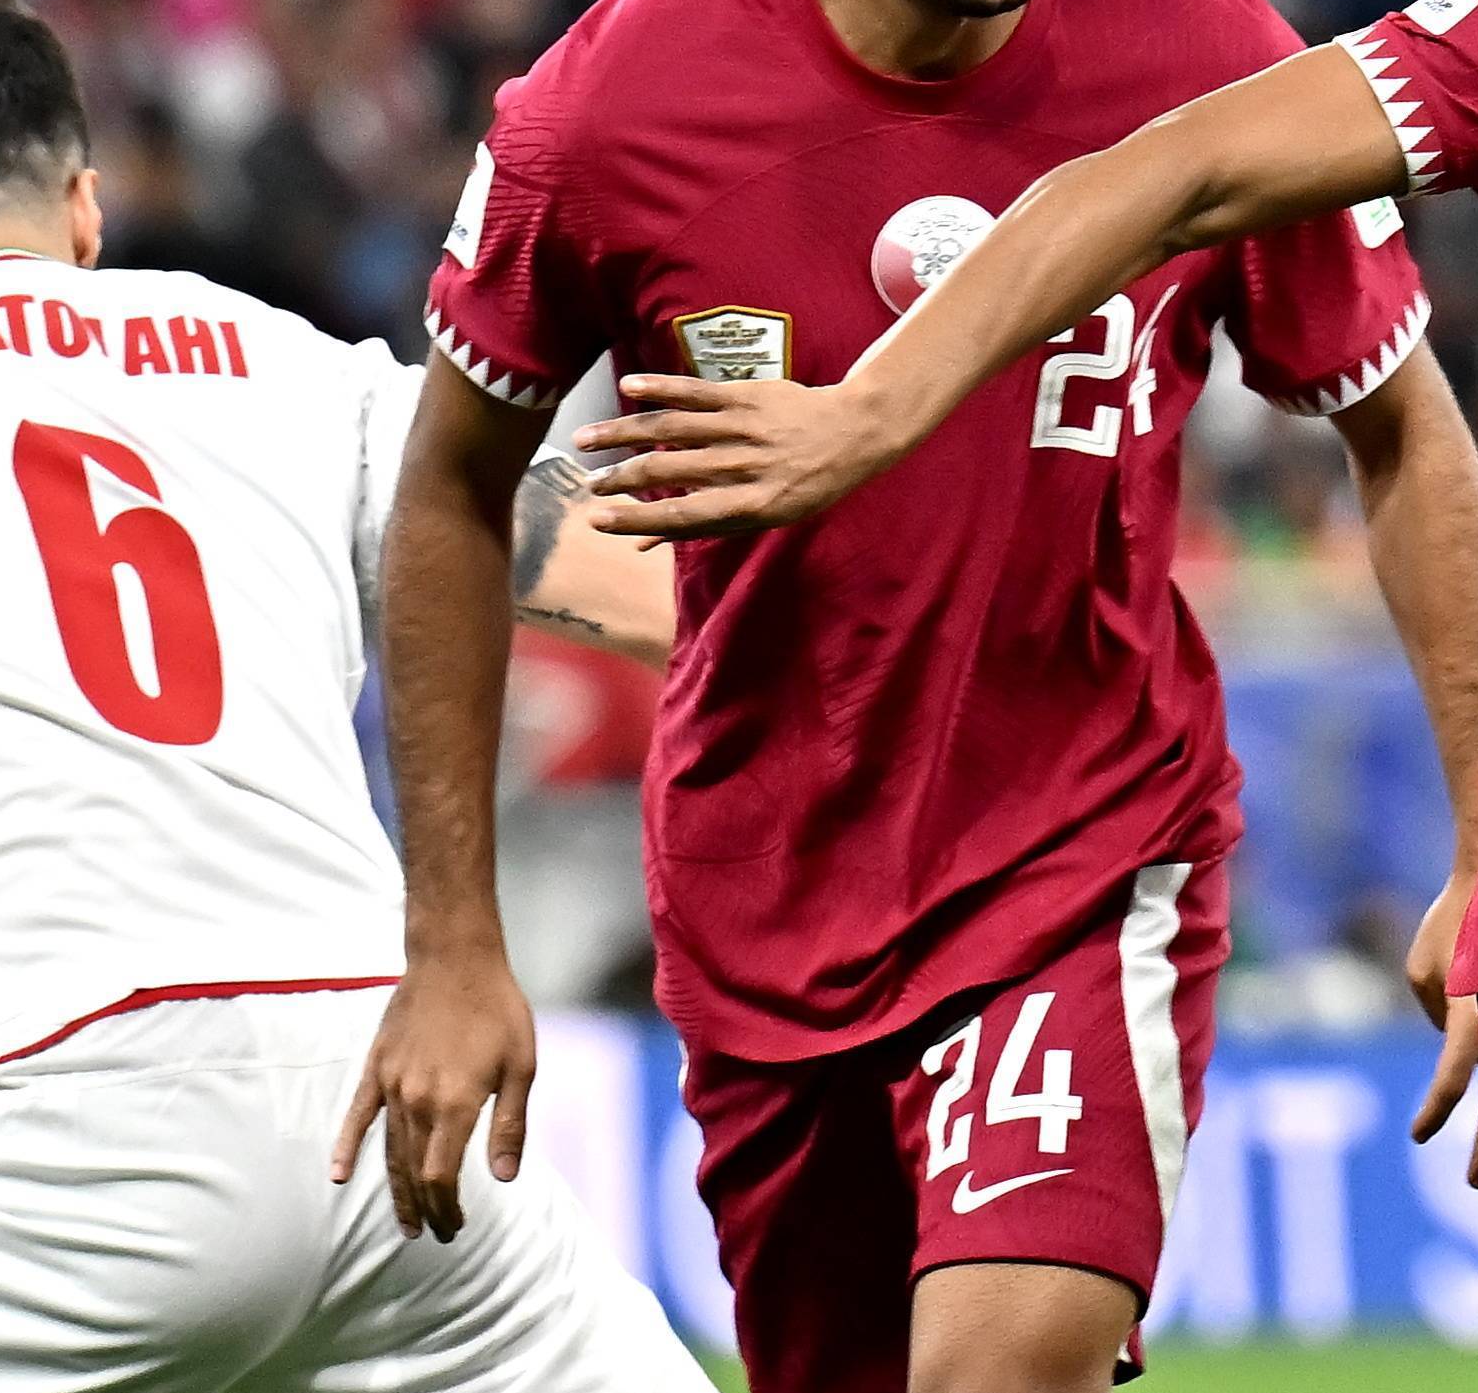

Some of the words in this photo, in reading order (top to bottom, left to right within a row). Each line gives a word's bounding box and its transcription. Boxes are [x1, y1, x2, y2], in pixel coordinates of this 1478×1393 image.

[1030, 282, 1180, 457] 24
[13, 419, 223, 745] 6
[921, 991, 1084, 1181] 24
